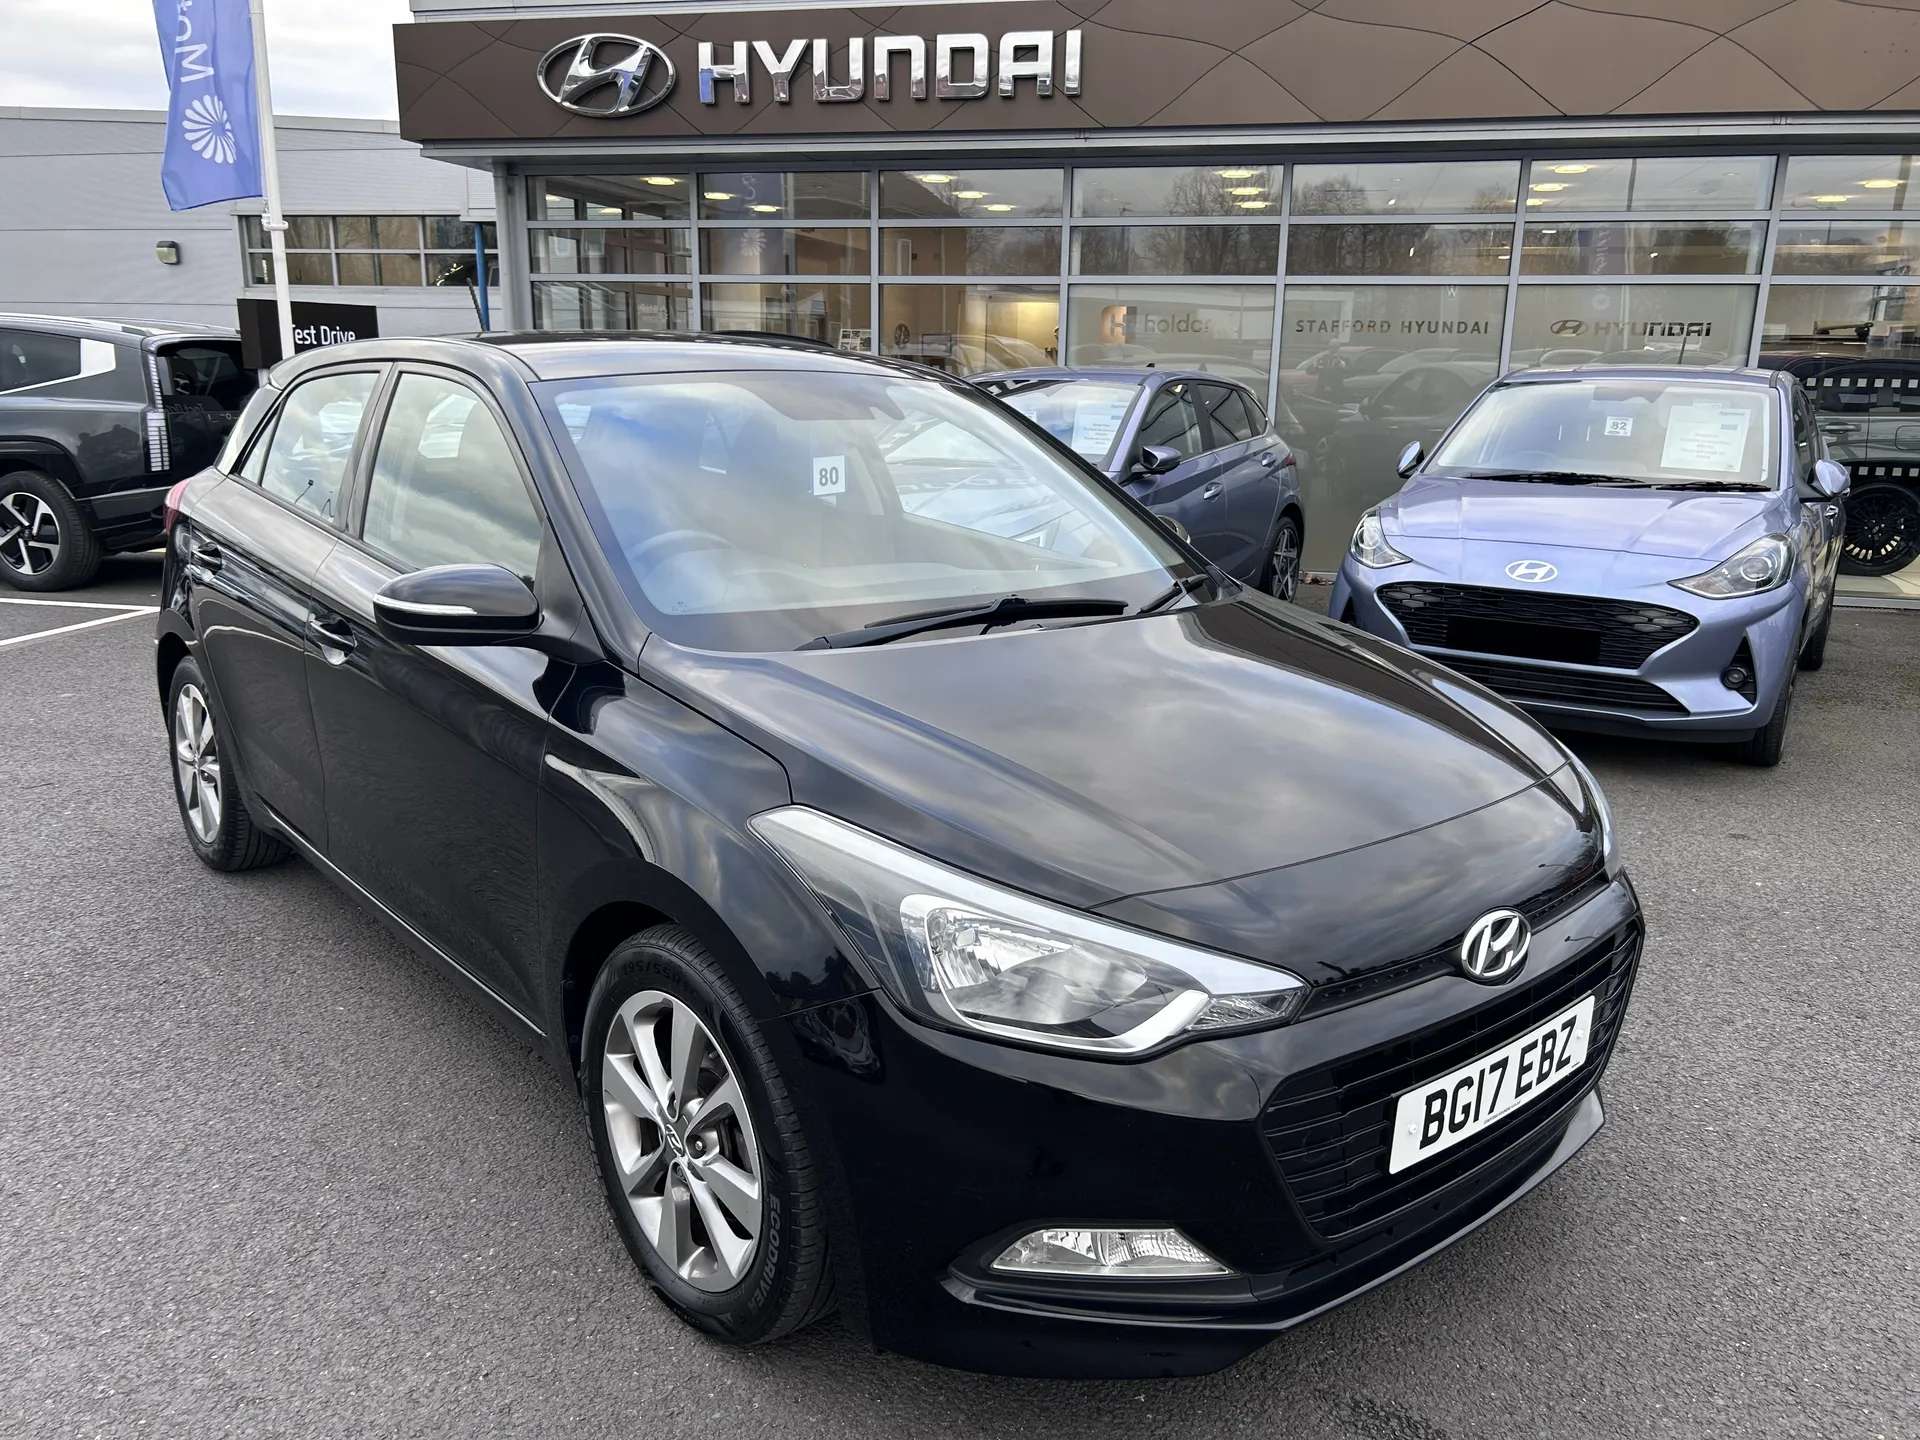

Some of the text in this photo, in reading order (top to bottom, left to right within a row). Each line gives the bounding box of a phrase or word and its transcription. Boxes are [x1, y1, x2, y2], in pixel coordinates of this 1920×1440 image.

[698, 29, 1083, 104] HYUNDAI
[292, 324, 356, 346] est Drive
[1296, 320, 1489, 335] STAFFORD HYUNDAI
[1595, 322, 1712, 337] HYUNDAI
[819, 466, 839, 487] 80
[1419, 1015, 1577, 1150] BG17 EBZ
